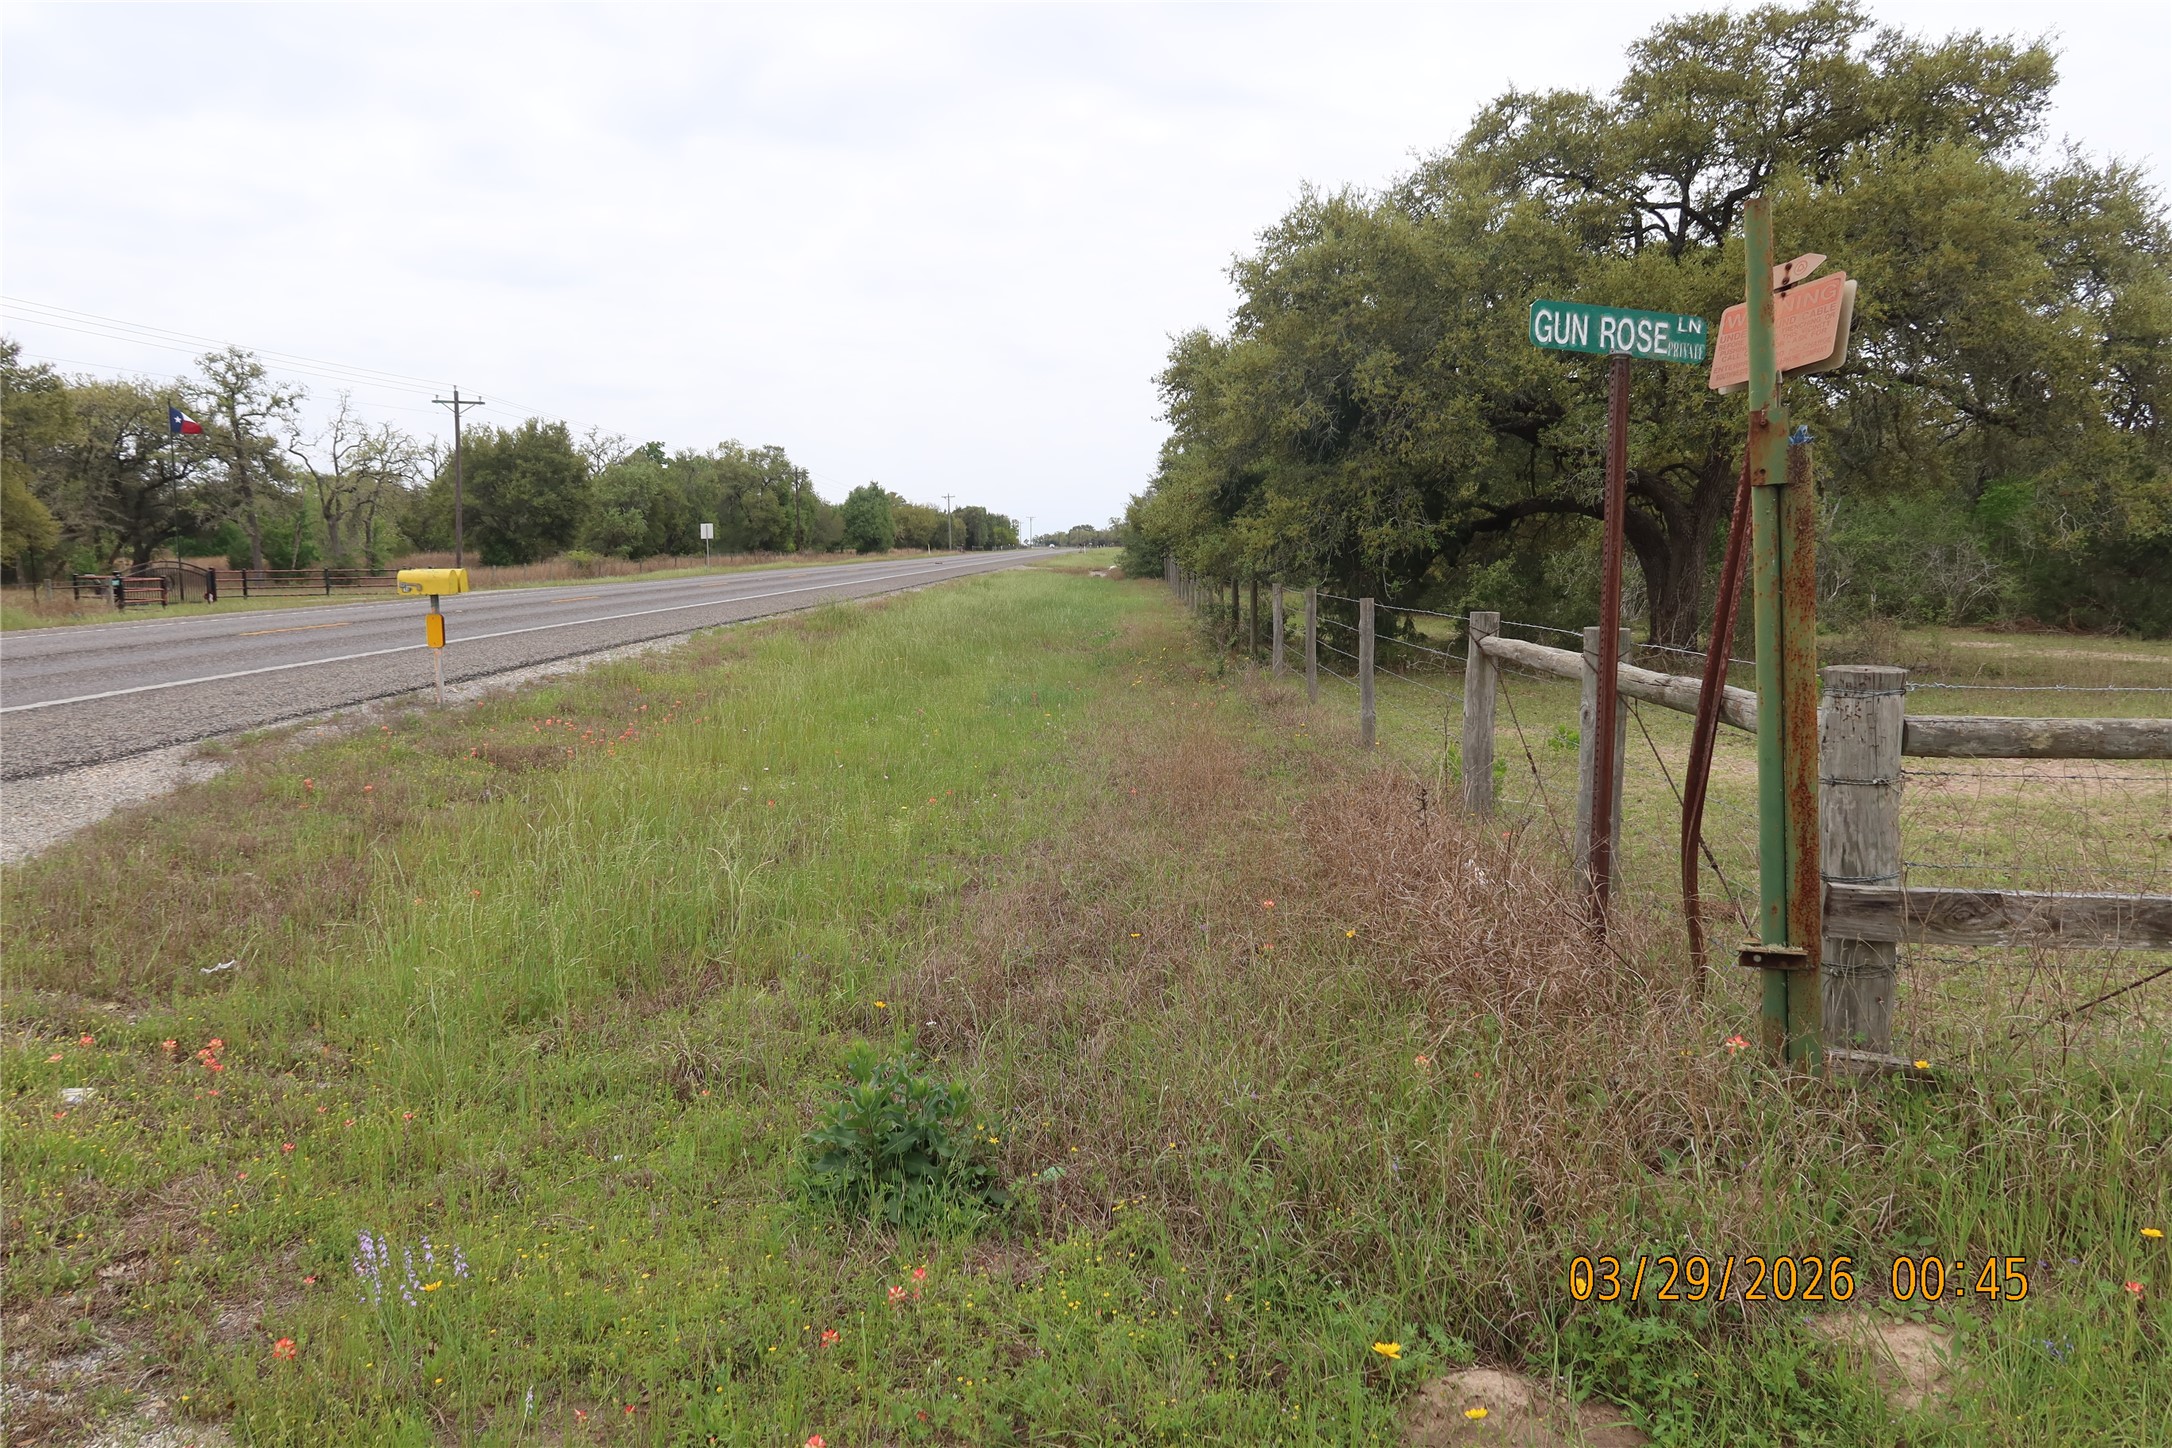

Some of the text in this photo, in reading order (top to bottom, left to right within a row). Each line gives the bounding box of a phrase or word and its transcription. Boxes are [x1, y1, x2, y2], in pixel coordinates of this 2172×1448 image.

[1801, 302, 1836, 319] CABLE
[1781, 311, 1835, 333] TRENCHING OR
[1534, 309, 1702, 354] GUN ROSE LN
[1810, 327, 1827, 337] FOR
[1721, 352, 1740, 363] CALL
